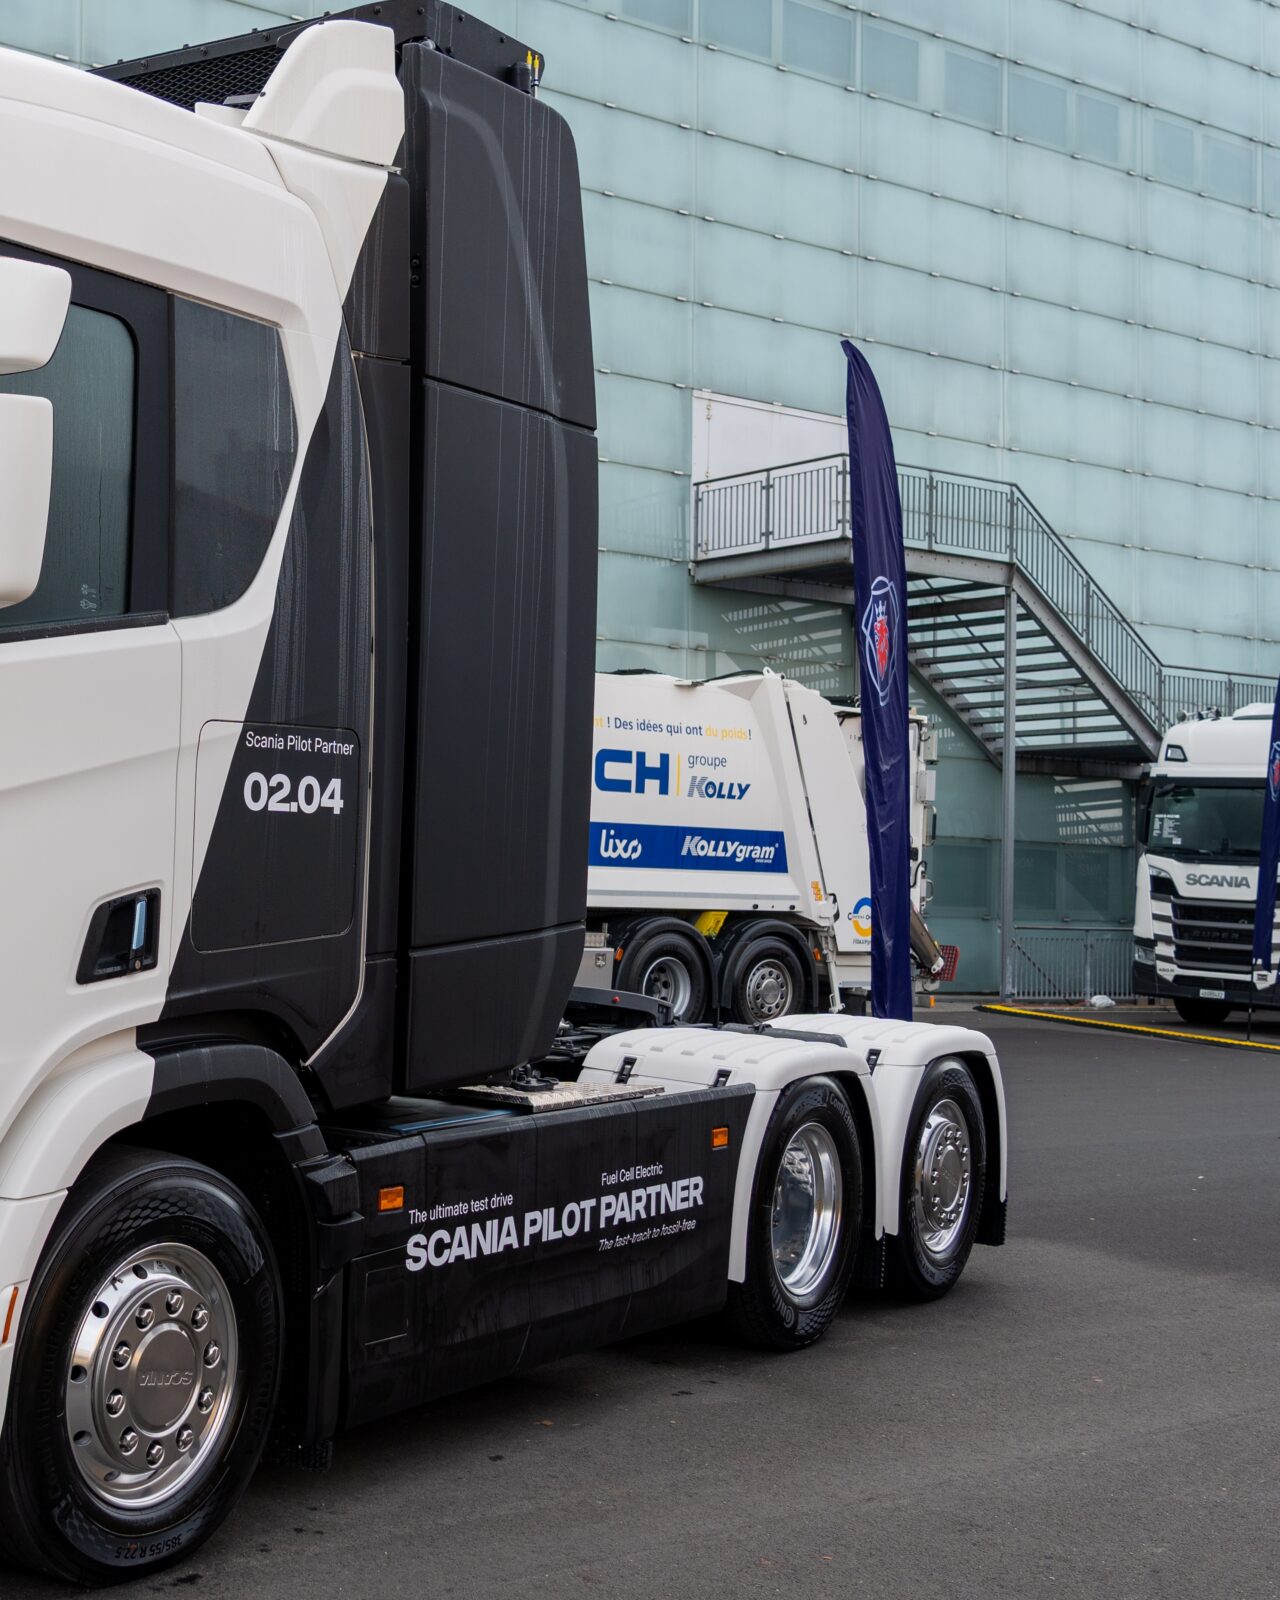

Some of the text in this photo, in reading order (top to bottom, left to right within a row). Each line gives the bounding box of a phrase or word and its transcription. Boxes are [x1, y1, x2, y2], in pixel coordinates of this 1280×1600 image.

[614, 717, 634, 730] Des
[636, 718, 664, 733] idées
[666, 722, 682, 736] qui
[686, 725, 702, 736] ont
[706, 725, 718, 737] du
[245, 731, 354, 756] Scania Pilot Partner
[688, 754, 727, 770] groupe
[243, 772, 344, 815] 02.04
[687, 776, 751, 800] KOLLY
[1186, 873, 1251, 889] SCANIA
[601, 1162, 663, 1186] Fuel Cell Electric
[408, 1192, 514, 1225] The ultimate test drive
[405, 1176, 704, 1272] SCANIA PILOT PARTNER
[598, 1218, 696, 1252] The fast-track to fossil-free
[138, 1546, 146, 1558] R
[148, 1533, 182, 1556] 385/55
